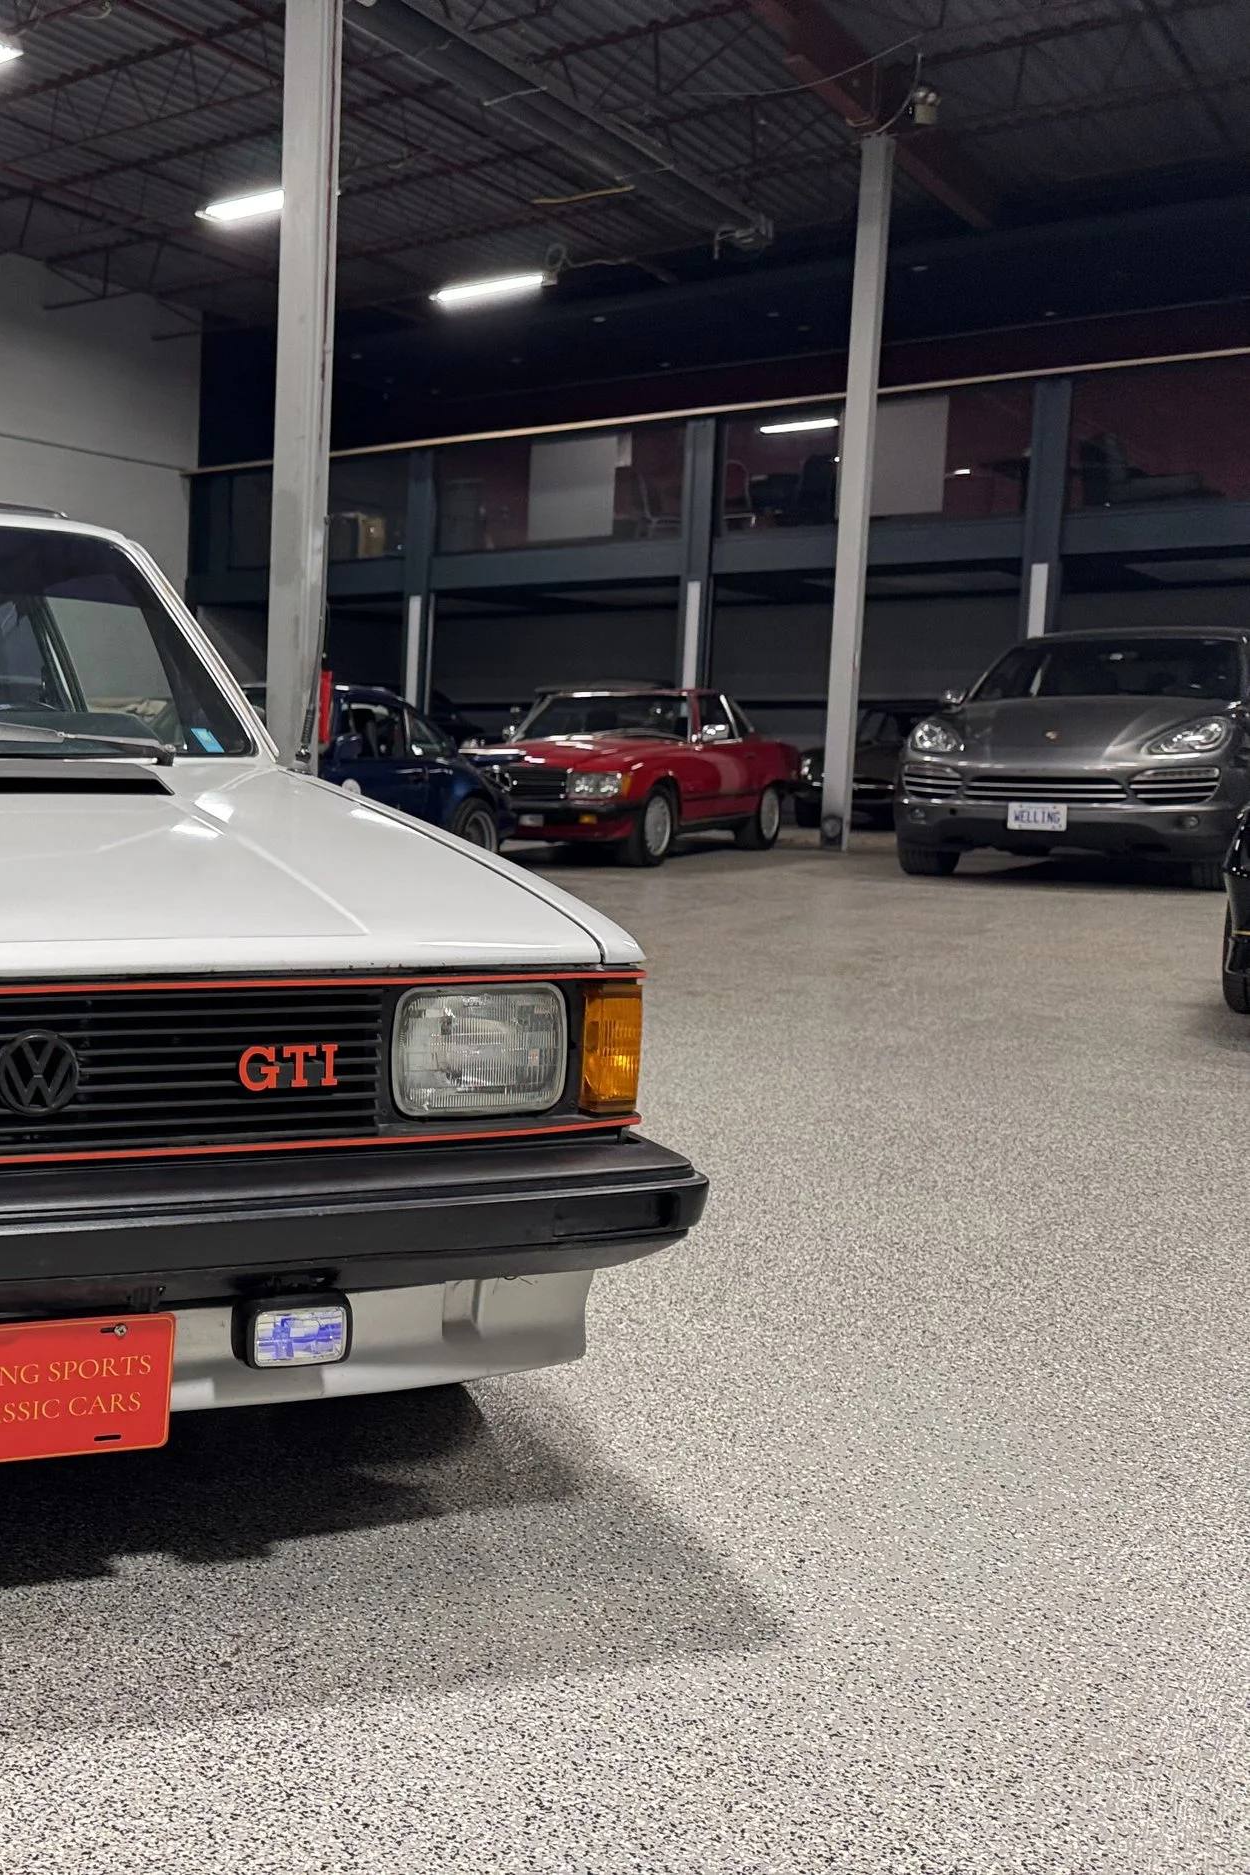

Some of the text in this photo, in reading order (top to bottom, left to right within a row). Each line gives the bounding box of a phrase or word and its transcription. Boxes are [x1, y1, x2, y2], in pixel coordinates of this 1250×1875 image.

[1013, 810, 1061, 824] WELLING
[238, 1044, 338, 1091] GTI
[47, 1354, 152, 1382] SPORTS
[68, 1391, 141, 1417] CARS
